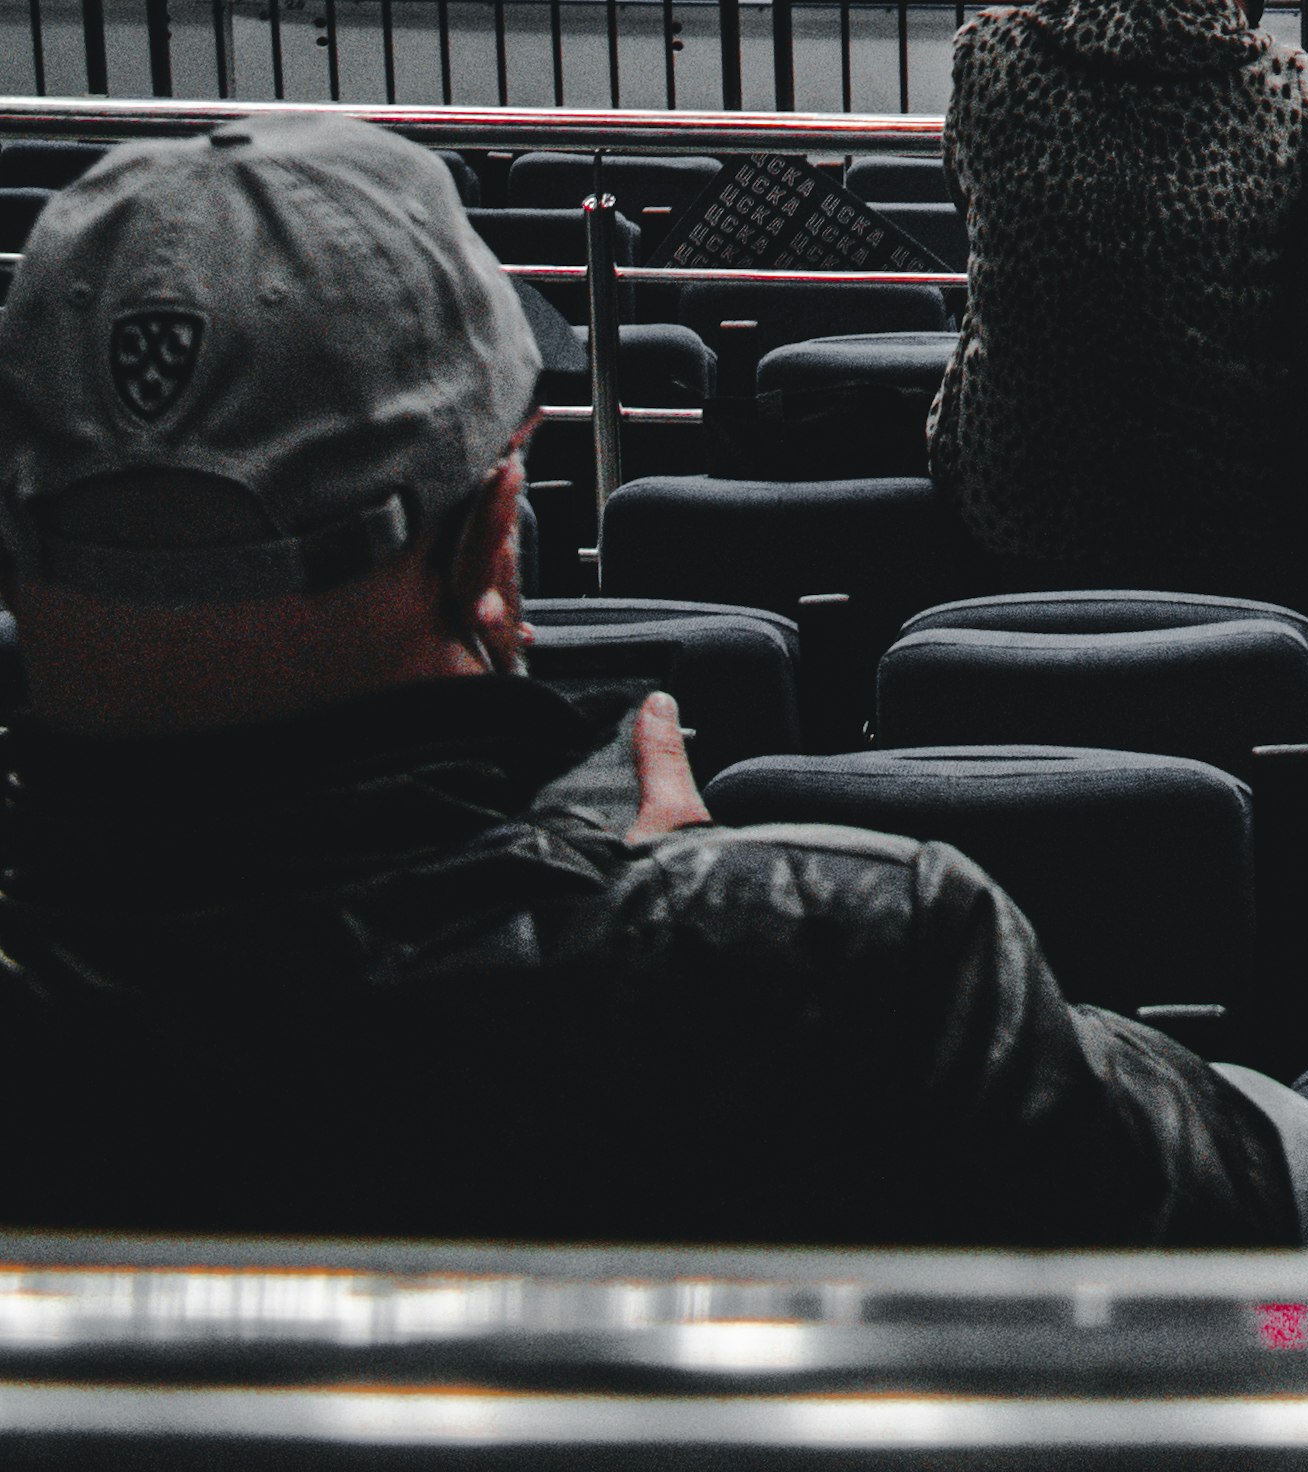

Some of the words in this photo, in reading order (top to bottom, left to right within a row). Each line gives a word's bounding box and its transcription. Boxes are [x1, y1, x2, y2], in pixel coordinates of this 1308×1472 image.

[719, 183, 786, 237] ЦСКА
[734, 164, 801, 217] ЦСКА
[703, 202, 768, 256] ЦСКА
[804, 211, 872, 267] ЦСКА
[820, 193, 885, 249] ЦСКА
